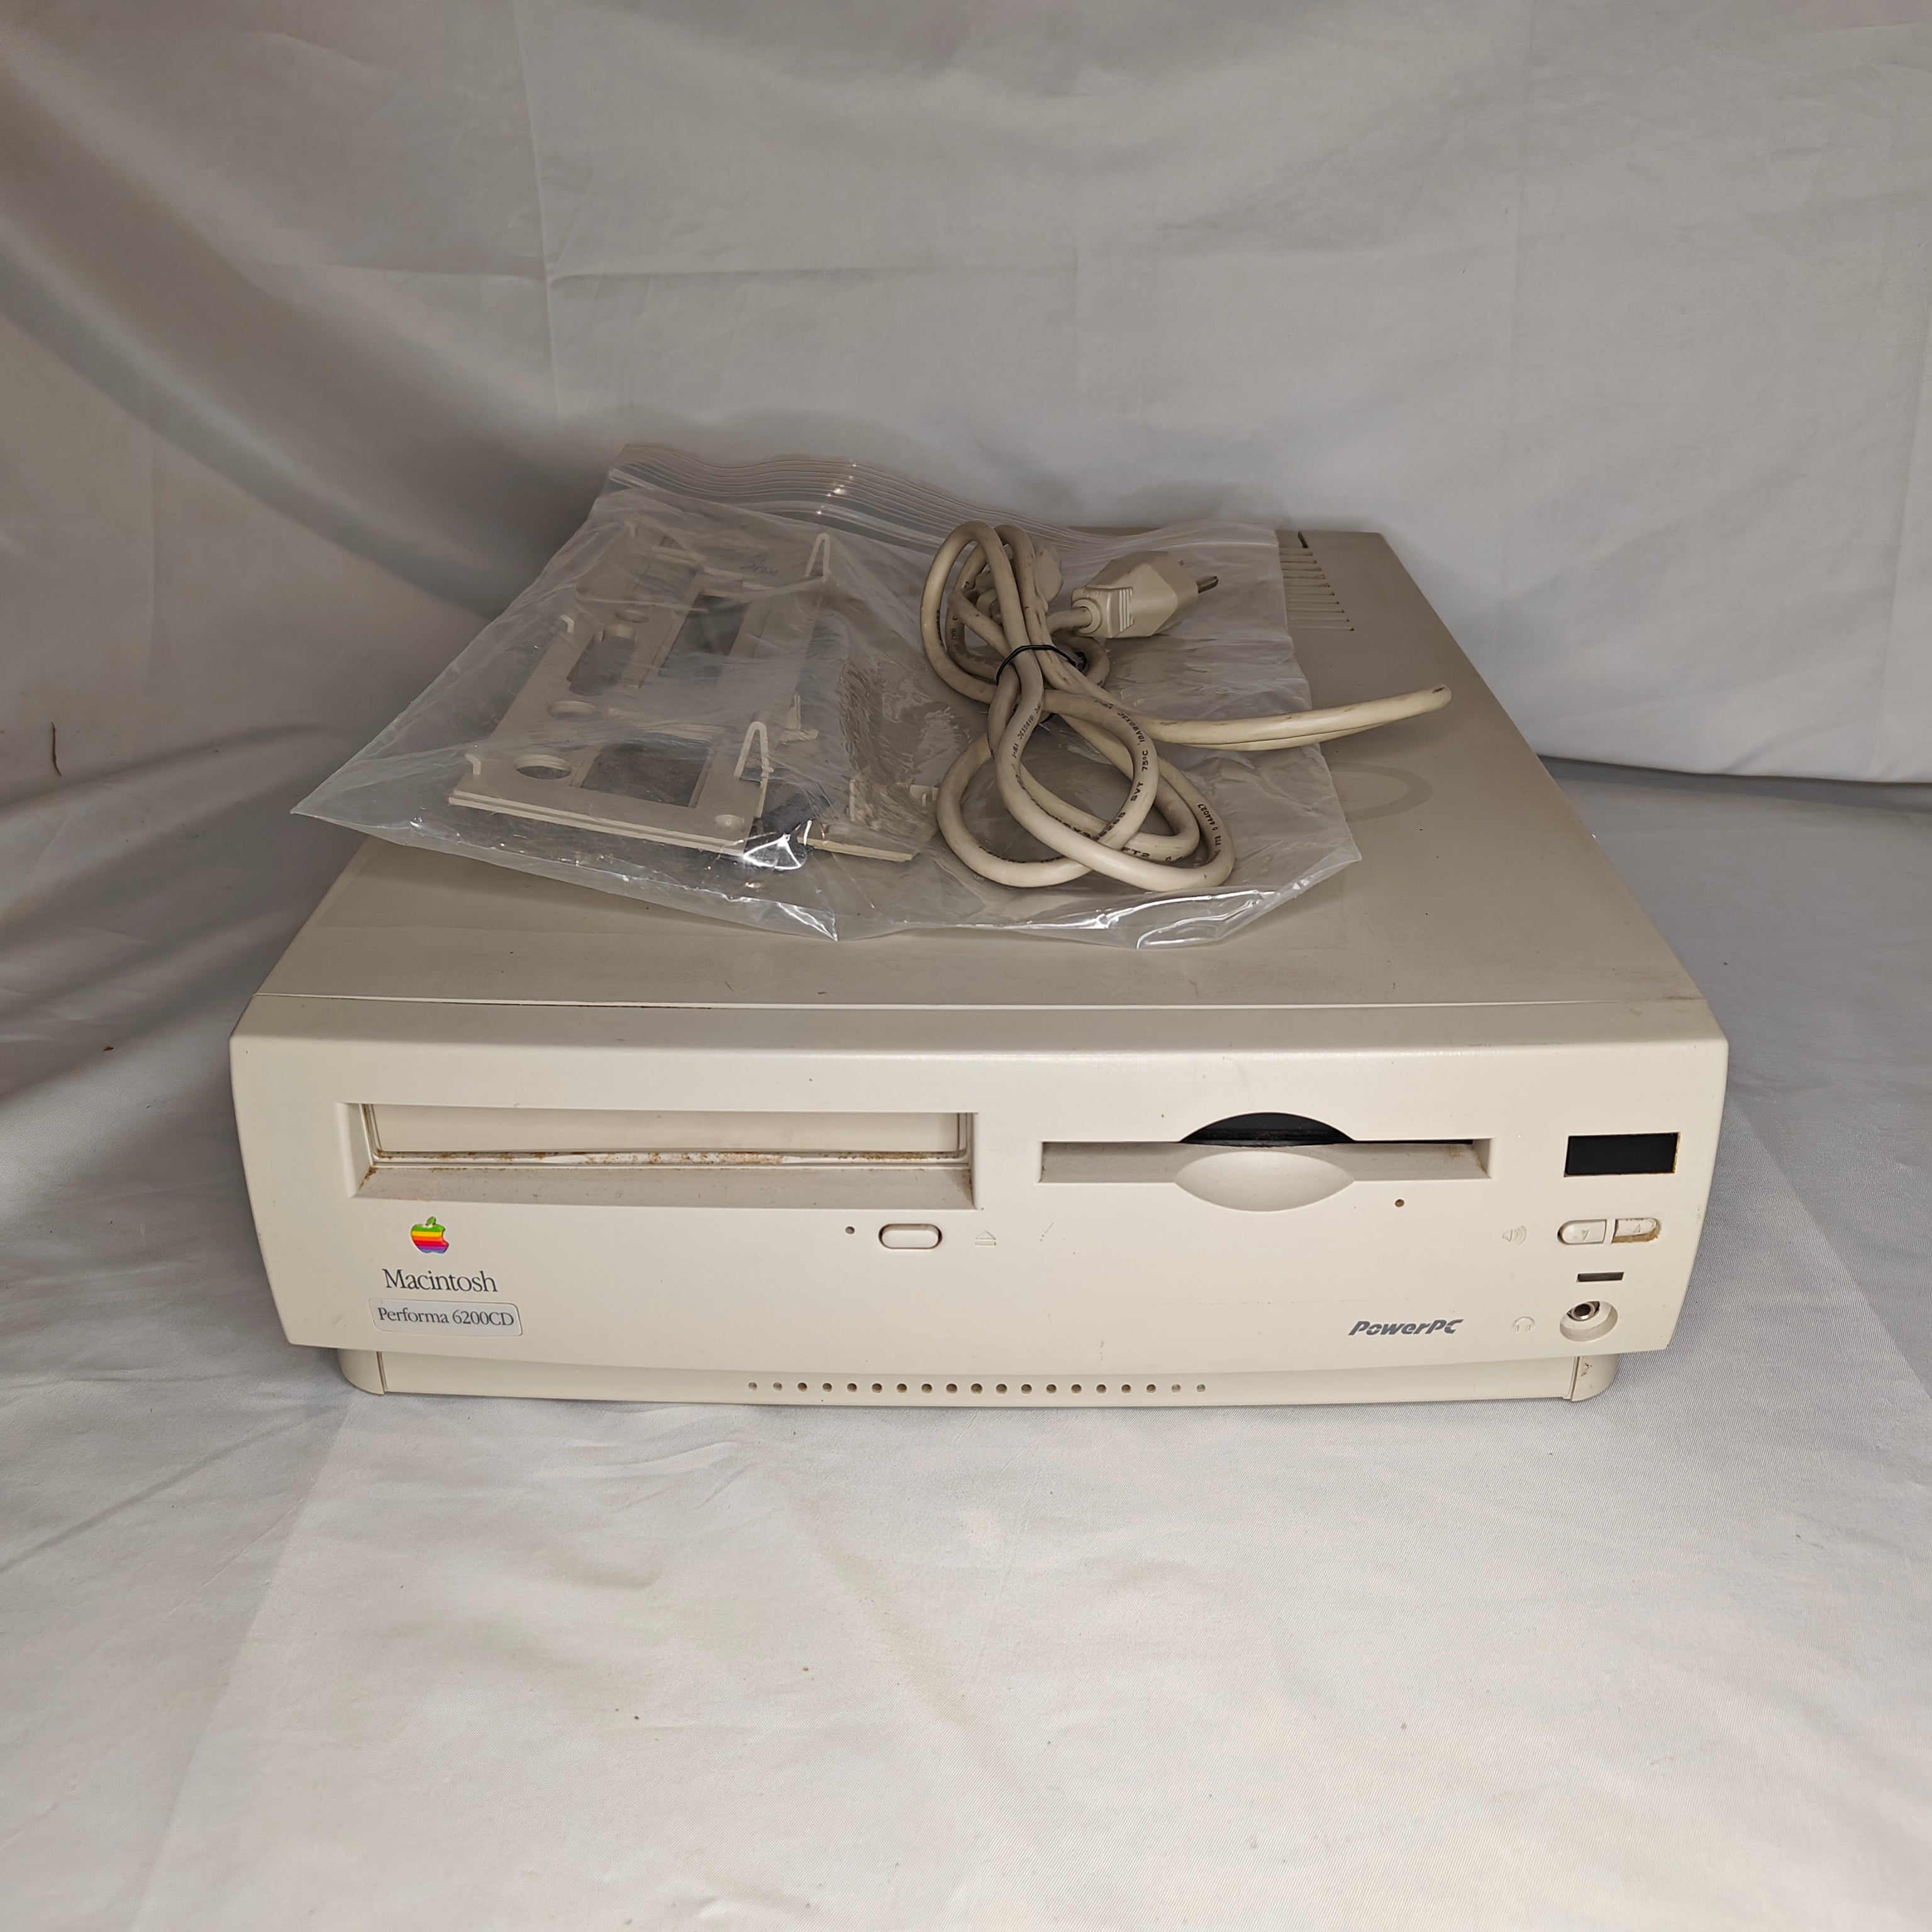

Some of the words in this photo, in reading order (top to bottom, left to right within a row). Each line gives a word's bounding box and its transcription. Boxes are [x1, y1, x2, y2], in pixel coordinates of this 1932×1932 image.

[381, 1268, 499, 1293] Macintosh
[377, 1307, 450, 1325] Performa
[452, 1309, 514, 1326] 6200CD
[1348, 1319, 1464, 1336] PowerPC
